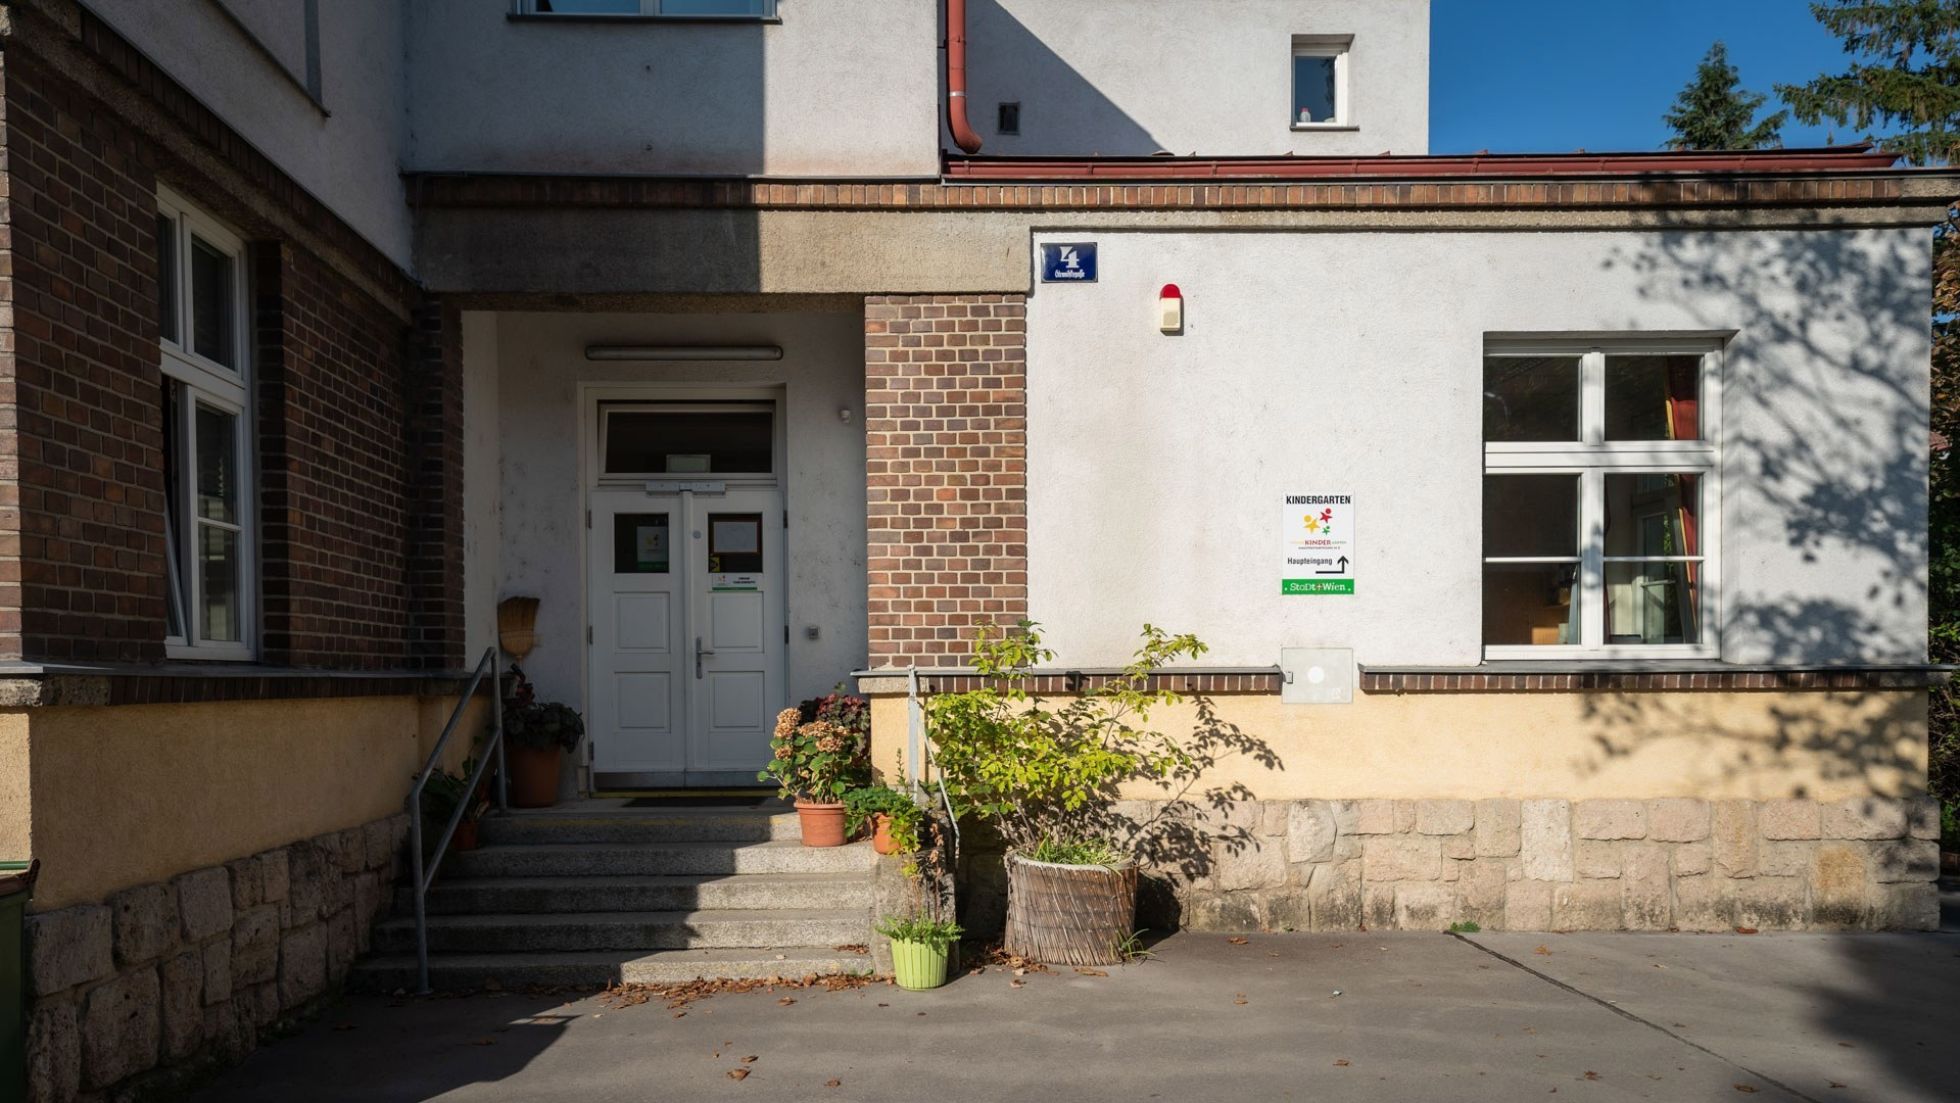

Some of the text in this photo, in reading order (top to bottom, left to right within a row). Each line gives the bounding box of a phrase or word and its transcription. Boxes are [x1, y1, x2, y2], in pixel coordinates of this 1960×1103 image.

[1059, 246, 1080, 268] 4
[1286, 495, 1351, 504] KINDERGARTEN
[1287, 557, 1333, 566] Haupteingang
